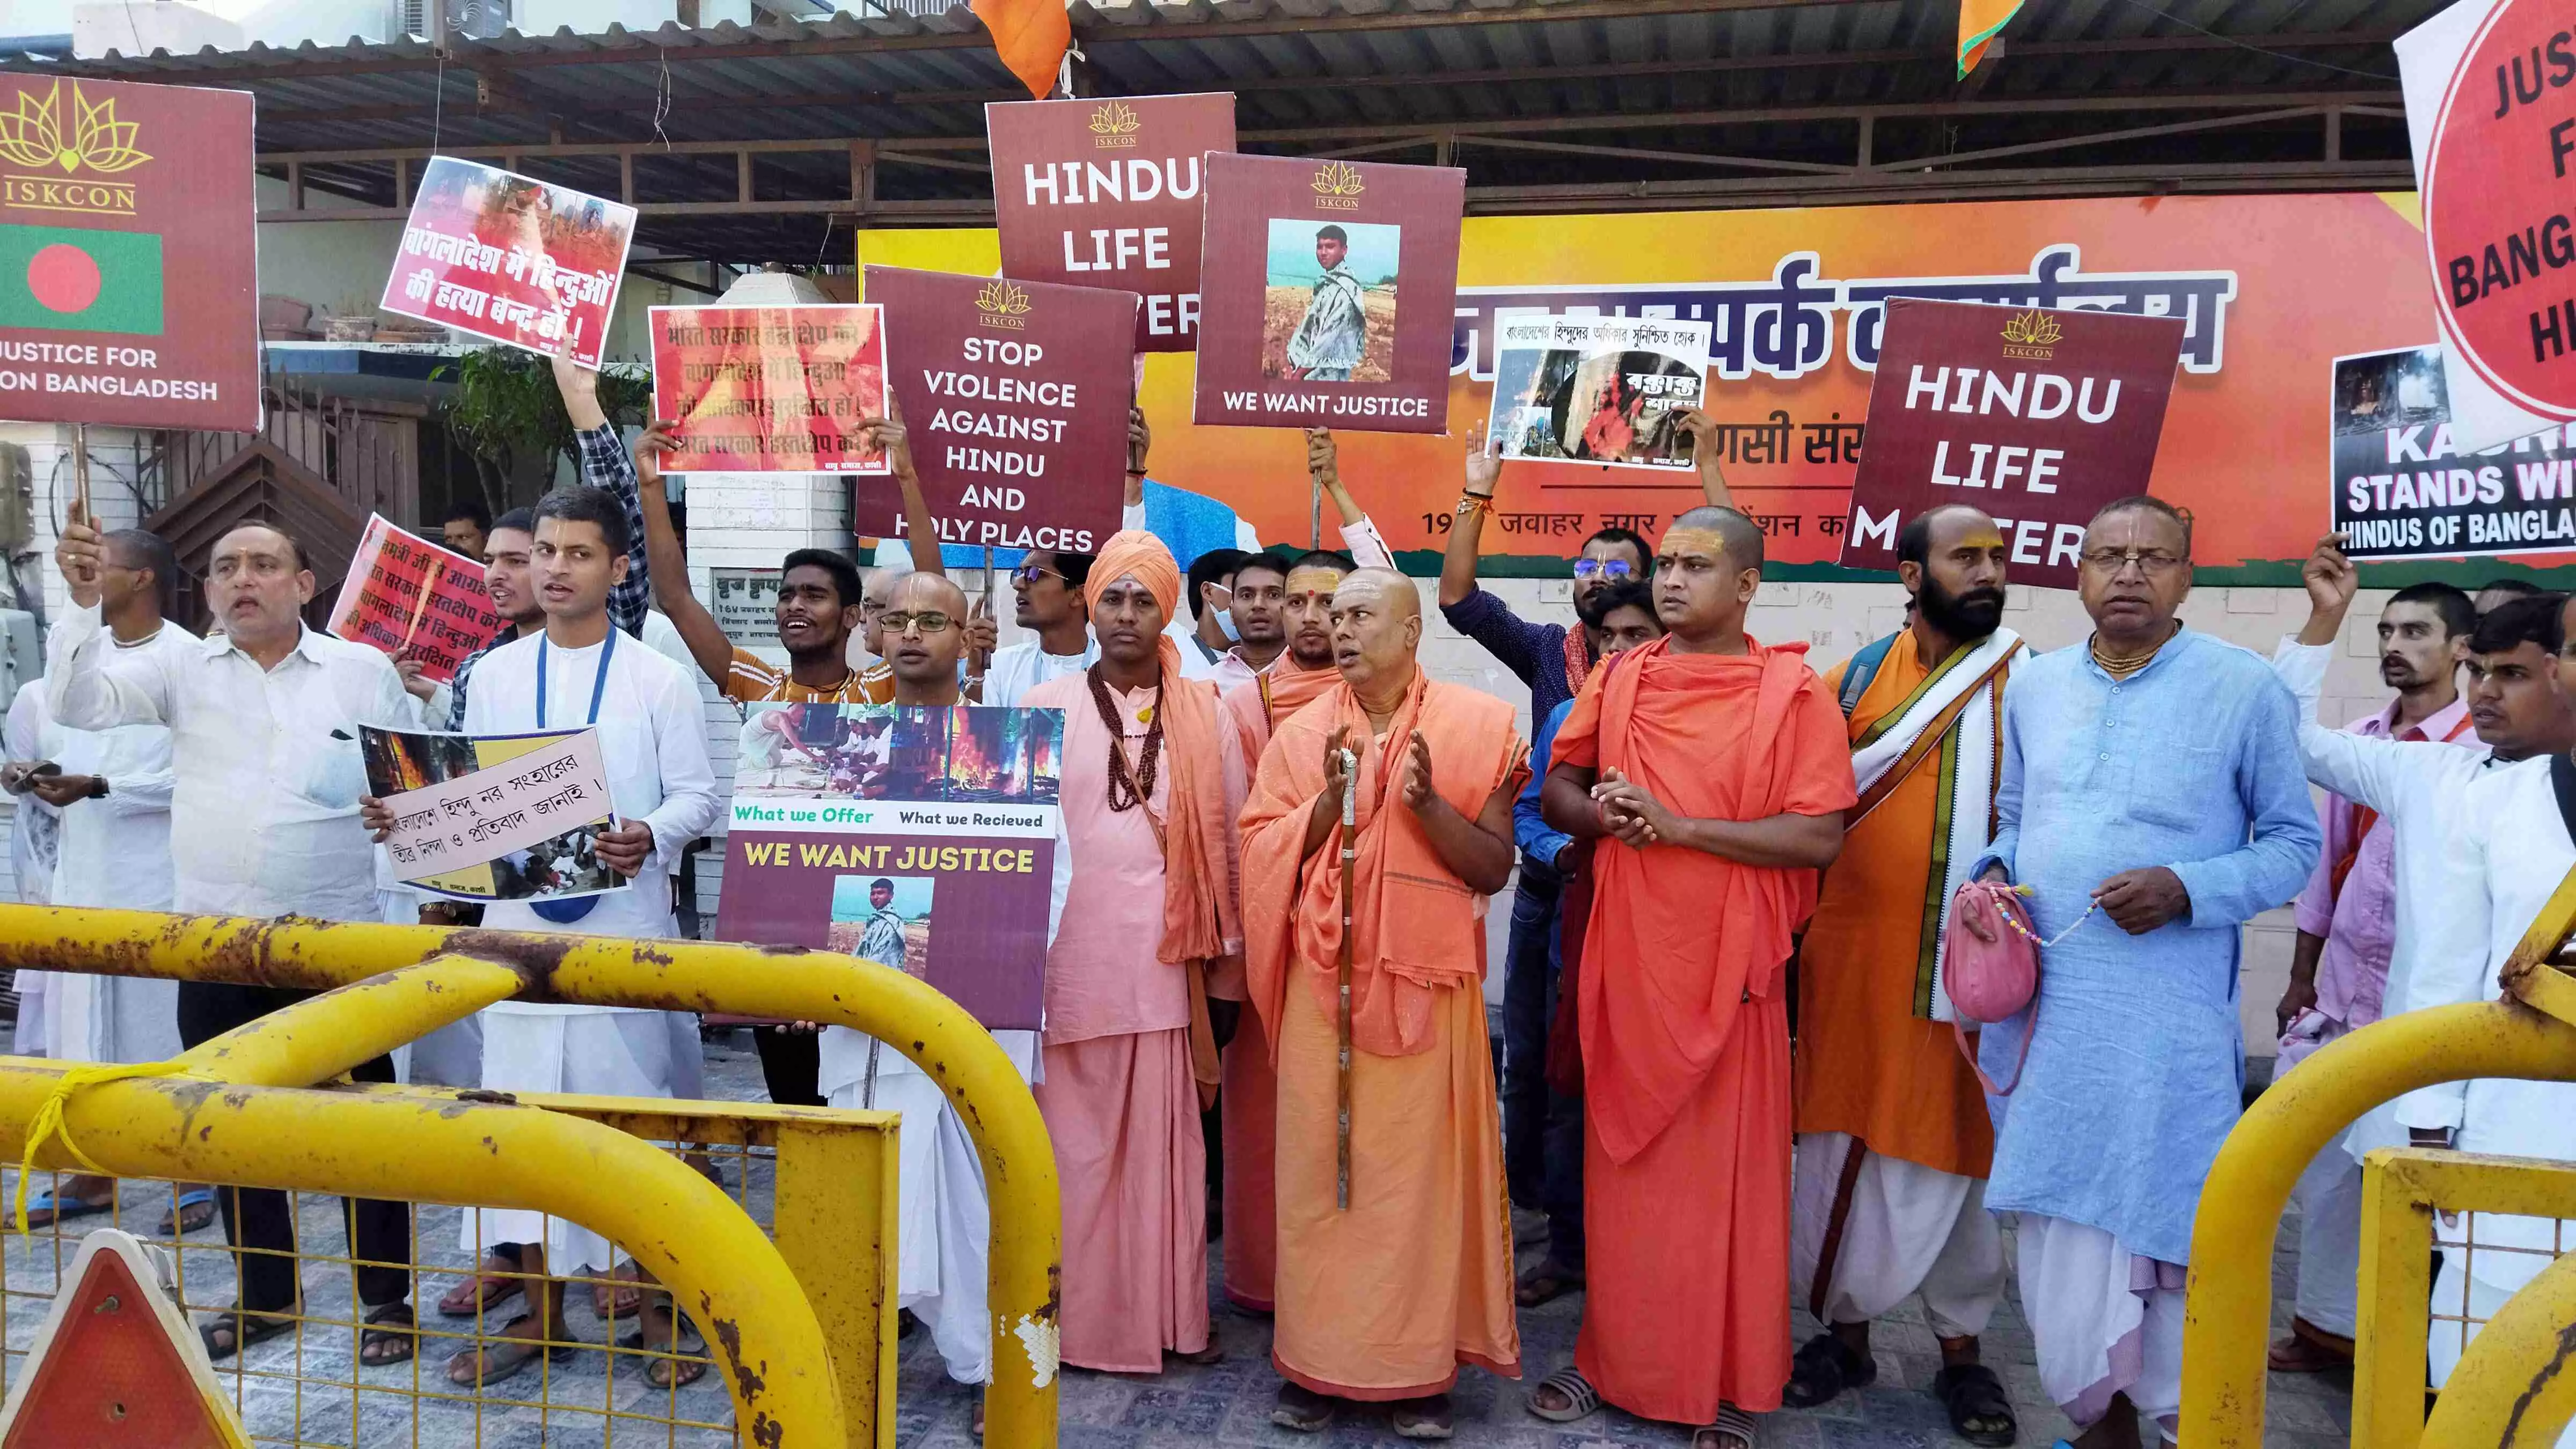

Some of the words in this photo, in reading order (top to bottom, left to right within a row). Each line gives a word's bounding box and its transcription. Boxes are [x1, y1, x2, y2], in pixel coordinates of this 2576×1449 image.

[2494, 25, 2576, 120] JUS
[1095, 136, 1137, 146] ISKCON
[5, 180, 135, 209] ISKCON
[1024, 157, 1199, 205] HINDU
[1315, 197, 1359, 208] ISKCON
[405, 222, 504, 275] बांगलादेश
[506, 245, 531, 282] में
[530, 253, 616, 308] हिन्दुओं
[1063, 228, 1170, 271] LIFE
[2449, 215, 2576, 308] BANG
[405, 268, 436, 304] की
[435, 280, 490, 319] हत्या
[489, 295, 538, 333] बन्द
[979, 315, 1026, 328] ISKCON
[107, 347, 157, 368] FOR
[963, 338, 1043, 367] STOP
[2003, 346, 2053, 358] ISKCON
[46, 372, 217, 400] BANGLADESH
[923, 369, 1077, 408] VIOLENCE
[1905, 365, 2121, 424] HINDU
[1223, 391, 1257, 411] WE
[1263, 393, 1330, 414] WANT
[1333, 396, 1429, 417] JUSTICE
[928, 408, 1067, 443] AGAINST
[946, 446, 1045, 477] HINDU
[1931, 441, 2065, 494] LIFE
[960, 484, 1026, 511] AND
[2348, 465, 2505, 513] STANDS
[2515, 459, 2576, 501] WI
[895, 514, 975, 542] HLY
[980, 522, 1093, 552] PLACES
[1498, 513, 1584, 537] जवाहर
[2340, 519, 2423, 550] HINDUS
[2429, 515, 2461, 545] OF
[2469, 508, 2576, 544] BANGLA
[430, 618, 484, 651] हिन्दुओं
[440, 797, 483, 821] হিন্দু
[476, 785, 505, 804] নর
[507, 754, 580, 791] সংহারের
[415, 838, 448, 860] নিন্দা
[450, 833, 464, 847] ও
[468, 809, 529, 843] প্রতিবাদ
[531, 783, 590, 815] জানাই
[735, 806, 785, 821] What
[790, 810, 816, 822] we
[822, 808, 874, 823] Offer
[899, 811, 941, 824] What
[947, 816, 968, 825] we
[973, 814, 1043, 827] Recieved
[744, 842, 791, 866] WE
[799, 844, 891, 869] WANT
[896, 846, 1034, 873] JUSTICE
